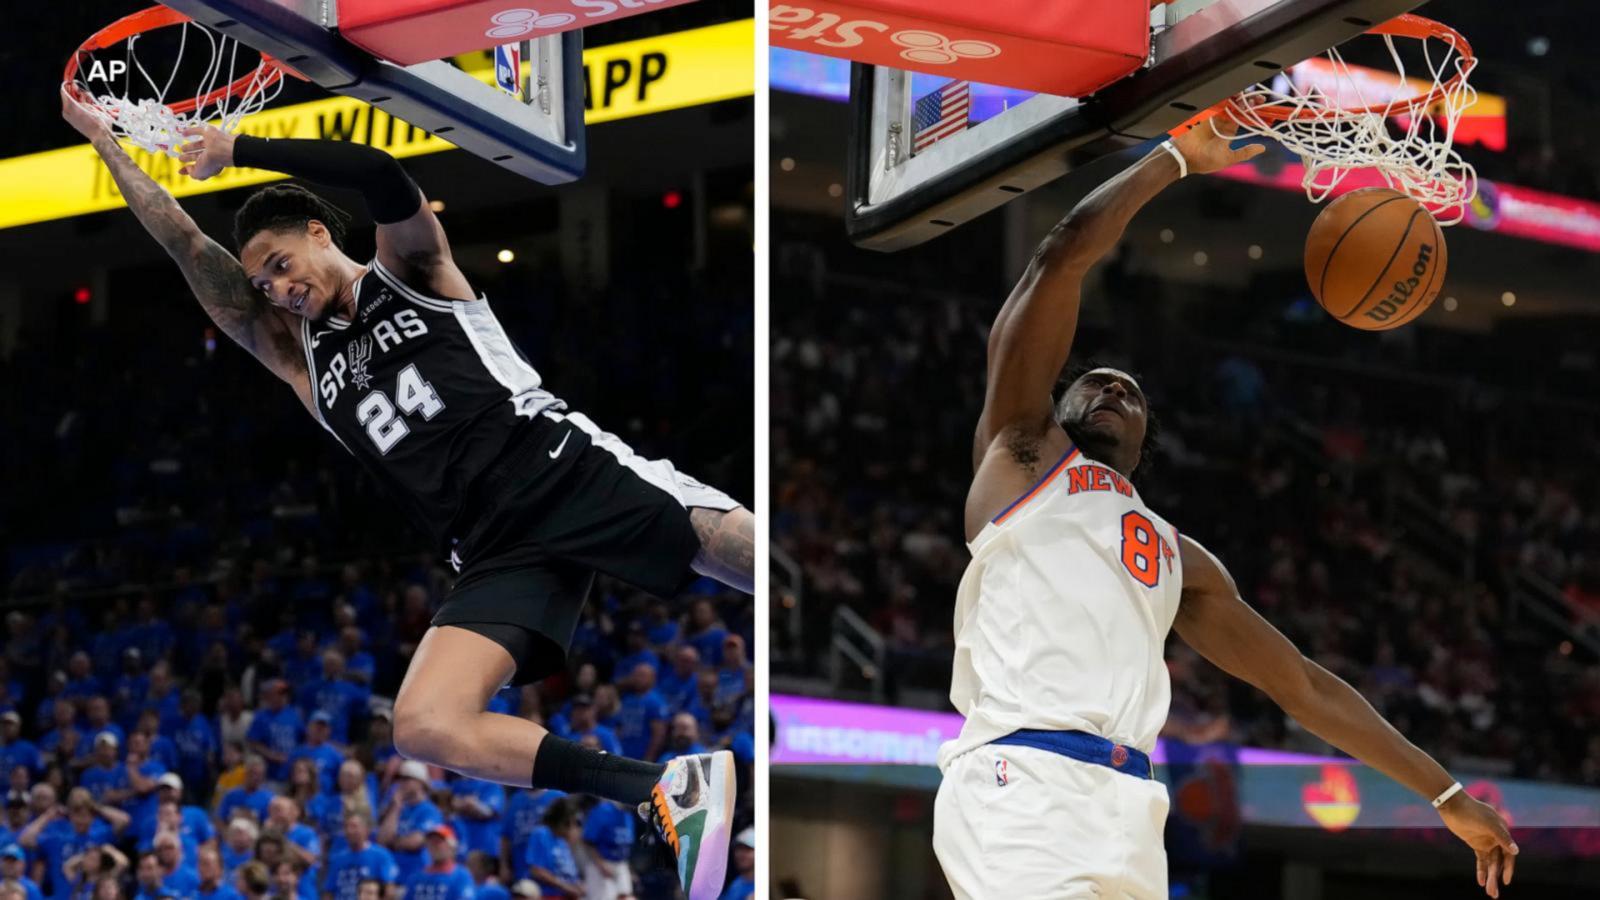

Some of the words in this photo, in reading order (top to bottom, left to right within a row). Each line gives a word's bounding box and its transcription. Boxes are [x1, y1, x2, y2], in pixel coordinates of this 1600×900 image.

[1363, 244, 1433, 322] Wilson
[356, 363, 446, 456] 24
[1067, 465, 1133, 498] NEW
